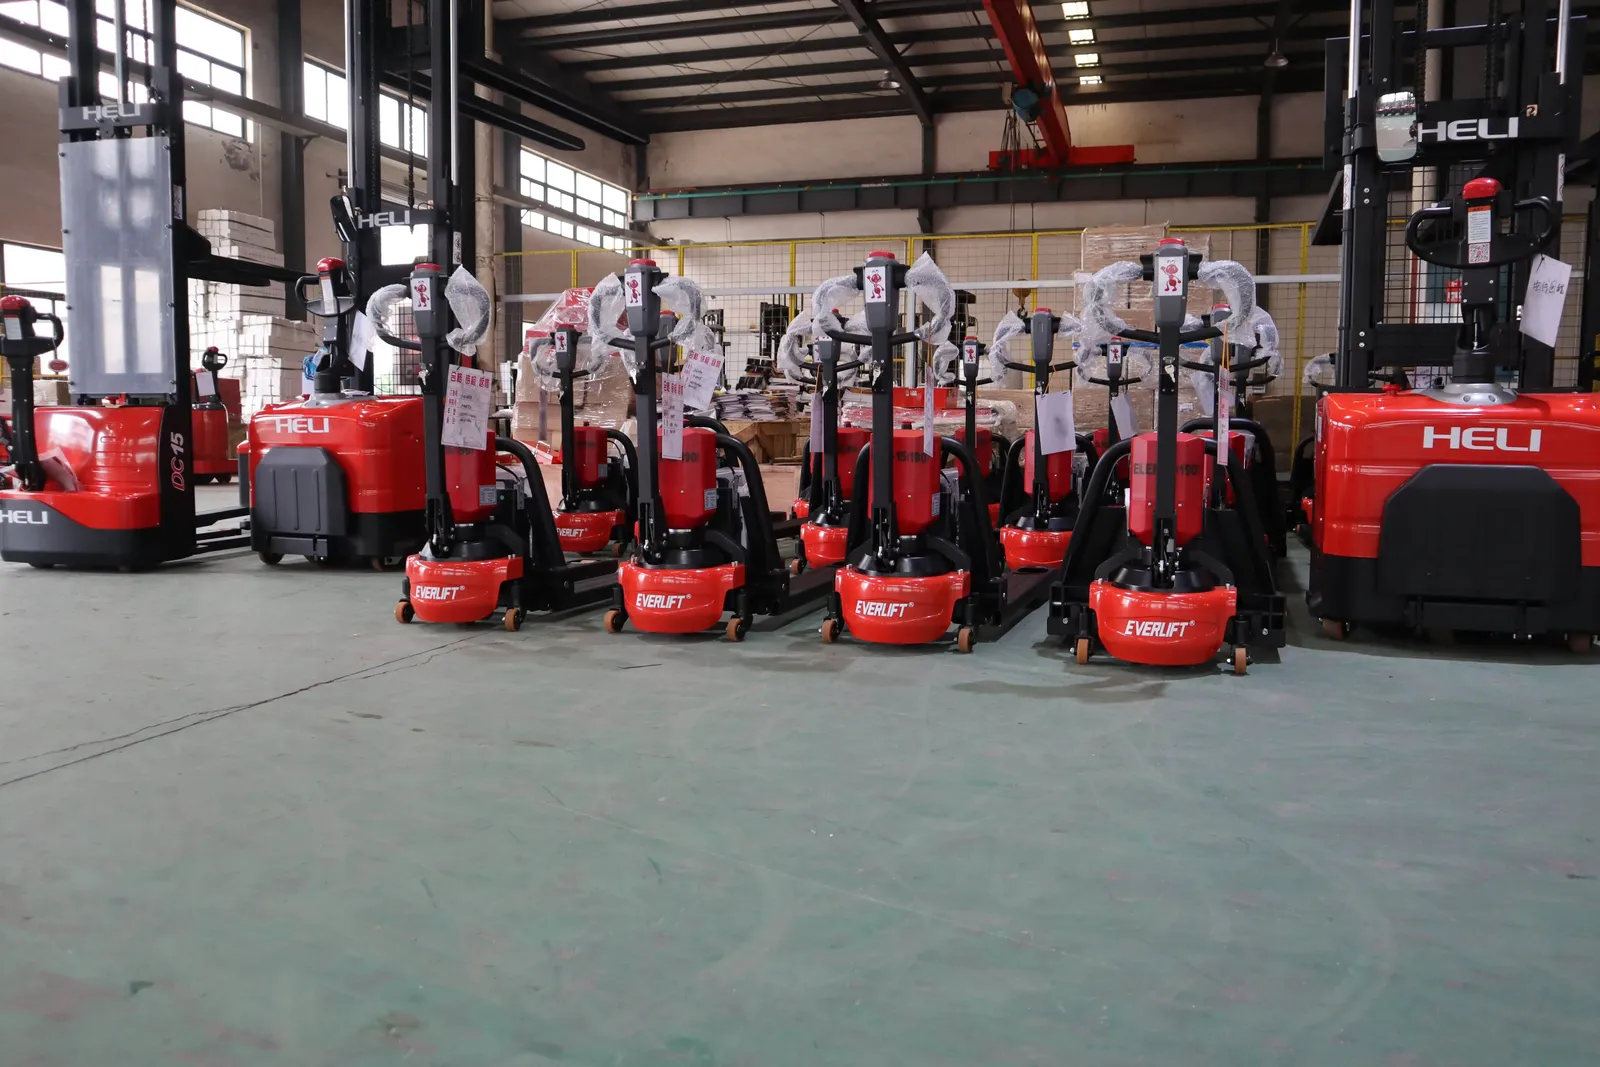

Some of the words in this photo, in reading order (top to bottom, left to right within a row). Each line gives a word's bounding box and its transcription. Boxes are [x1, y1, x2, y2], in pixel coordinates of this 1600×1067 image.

[82, 104, 141, 120] HELI
[1417, 116, 1519, 143] HELI
[357, 210, 411, 229] HELI
[275, 417, 330, 434] HELI
[1422, 425, 1542, 453] HELI
[0, 509, 48, 525] HELI
